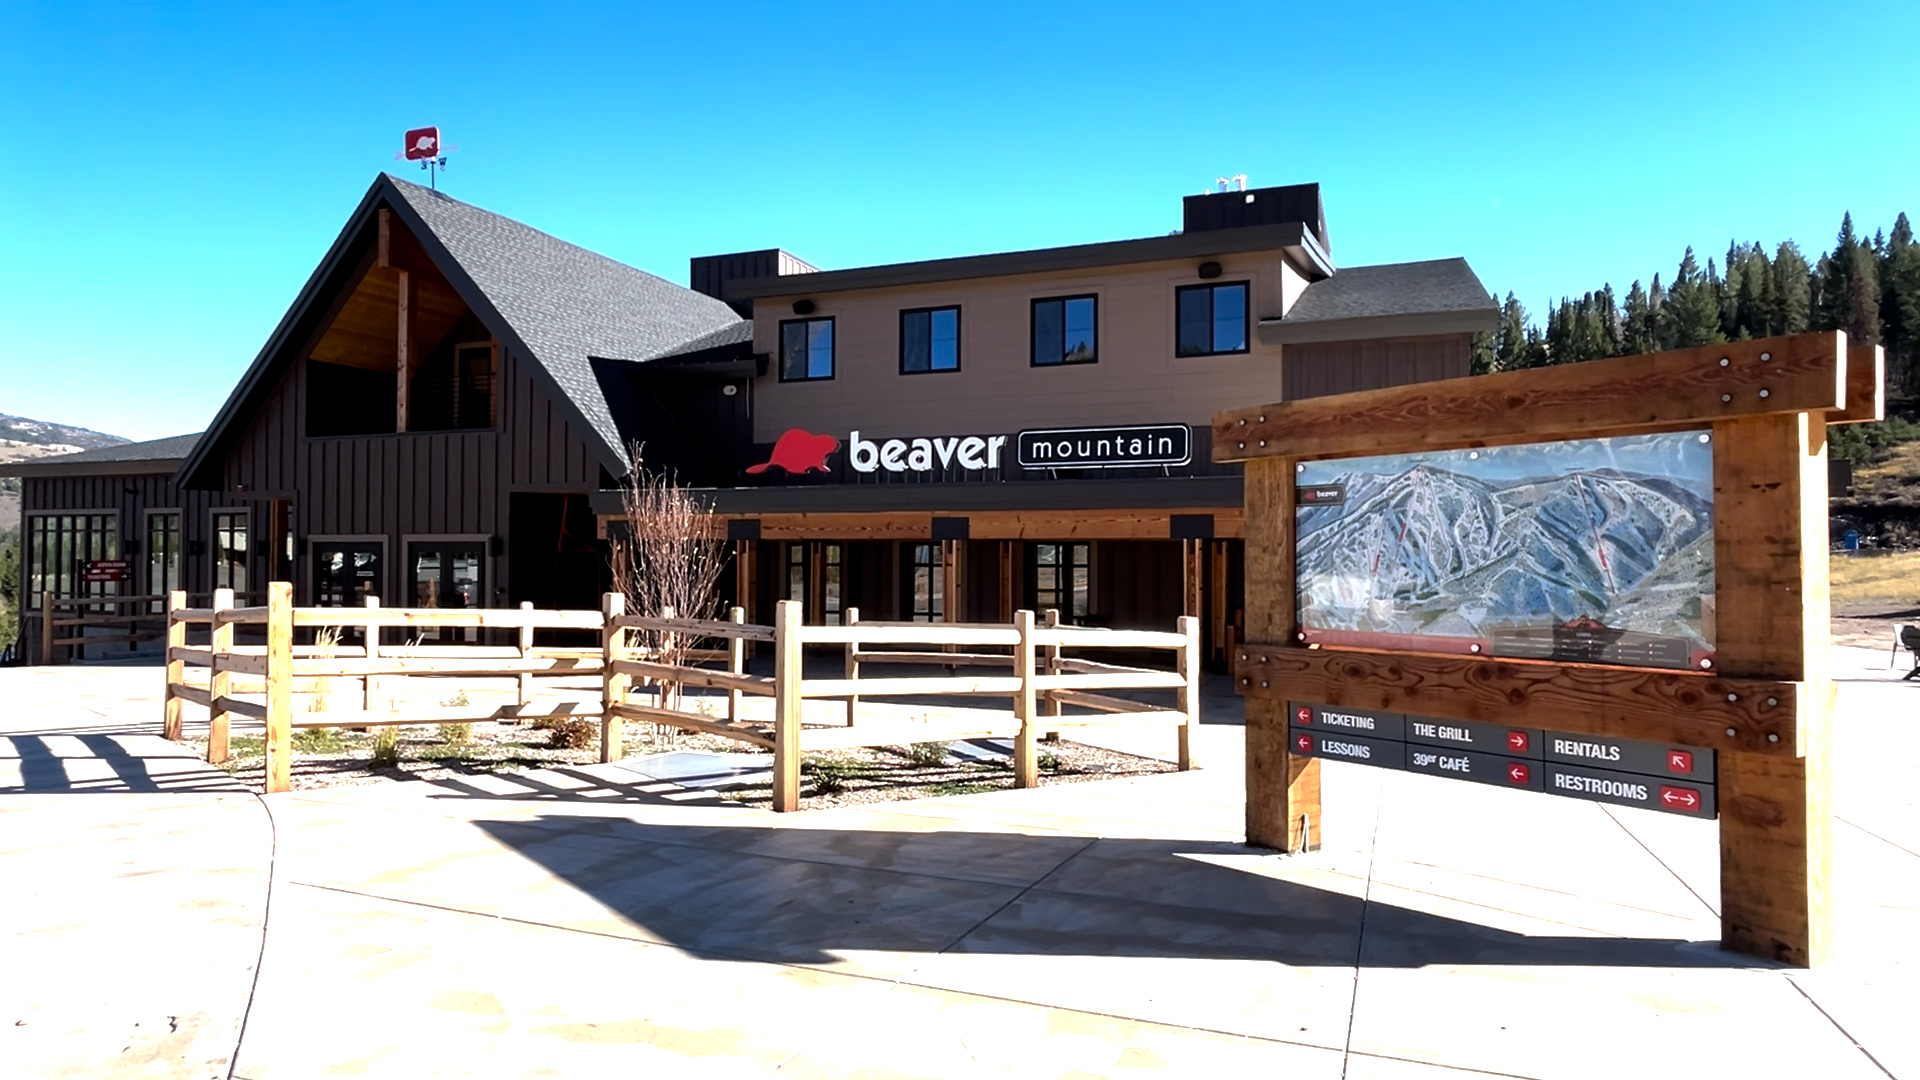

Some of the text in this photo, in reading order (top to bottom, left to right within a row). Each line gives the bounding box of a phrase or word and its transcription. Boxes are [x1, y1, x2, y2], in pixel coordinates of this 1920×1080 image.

[850, 430, 1007, 473] beaver
[1032, 434, 1172, 459] mountain
[1321, 711, 1375, 730] TICKETING
[1413, 722, 1473, 742] THE GRILL
[1322, 740, 1371, 759] LESSONS
[1554, 739, 1621, 761] RENTALS
[1413, 752, 1470, 773] 39er CAFÉ
[1555, 773, 1648, 801] RESTROOMS
